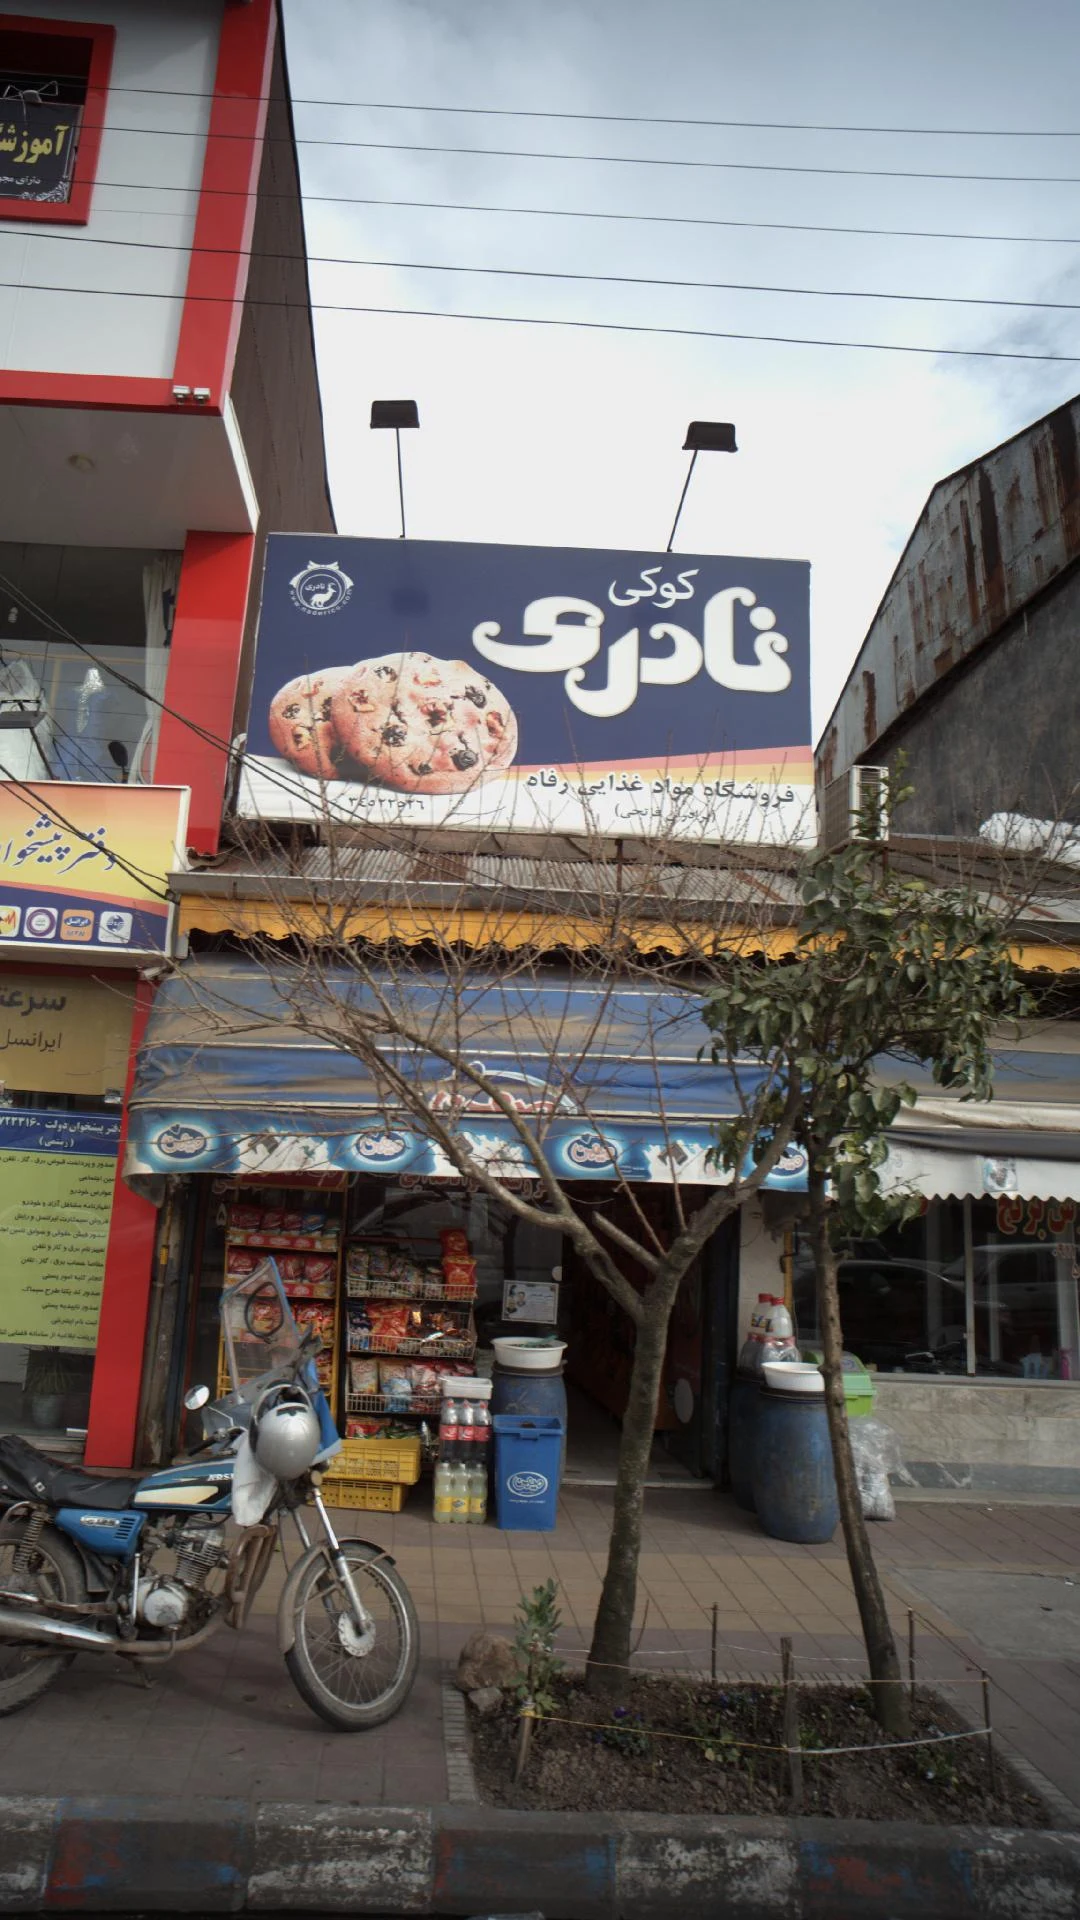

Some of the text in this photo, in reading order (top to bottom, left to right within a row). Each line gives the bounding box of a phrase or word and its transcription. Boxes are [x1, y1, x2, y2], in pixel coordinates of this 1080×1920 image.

[608, 566, 699, 608] کوکی
[471, 586, 792, 718] نادری
[526, 769, 794, 808] فروشگاه مواد غذایی رفاه
[0, 813, 117, 875] دفتر پیشخوا
